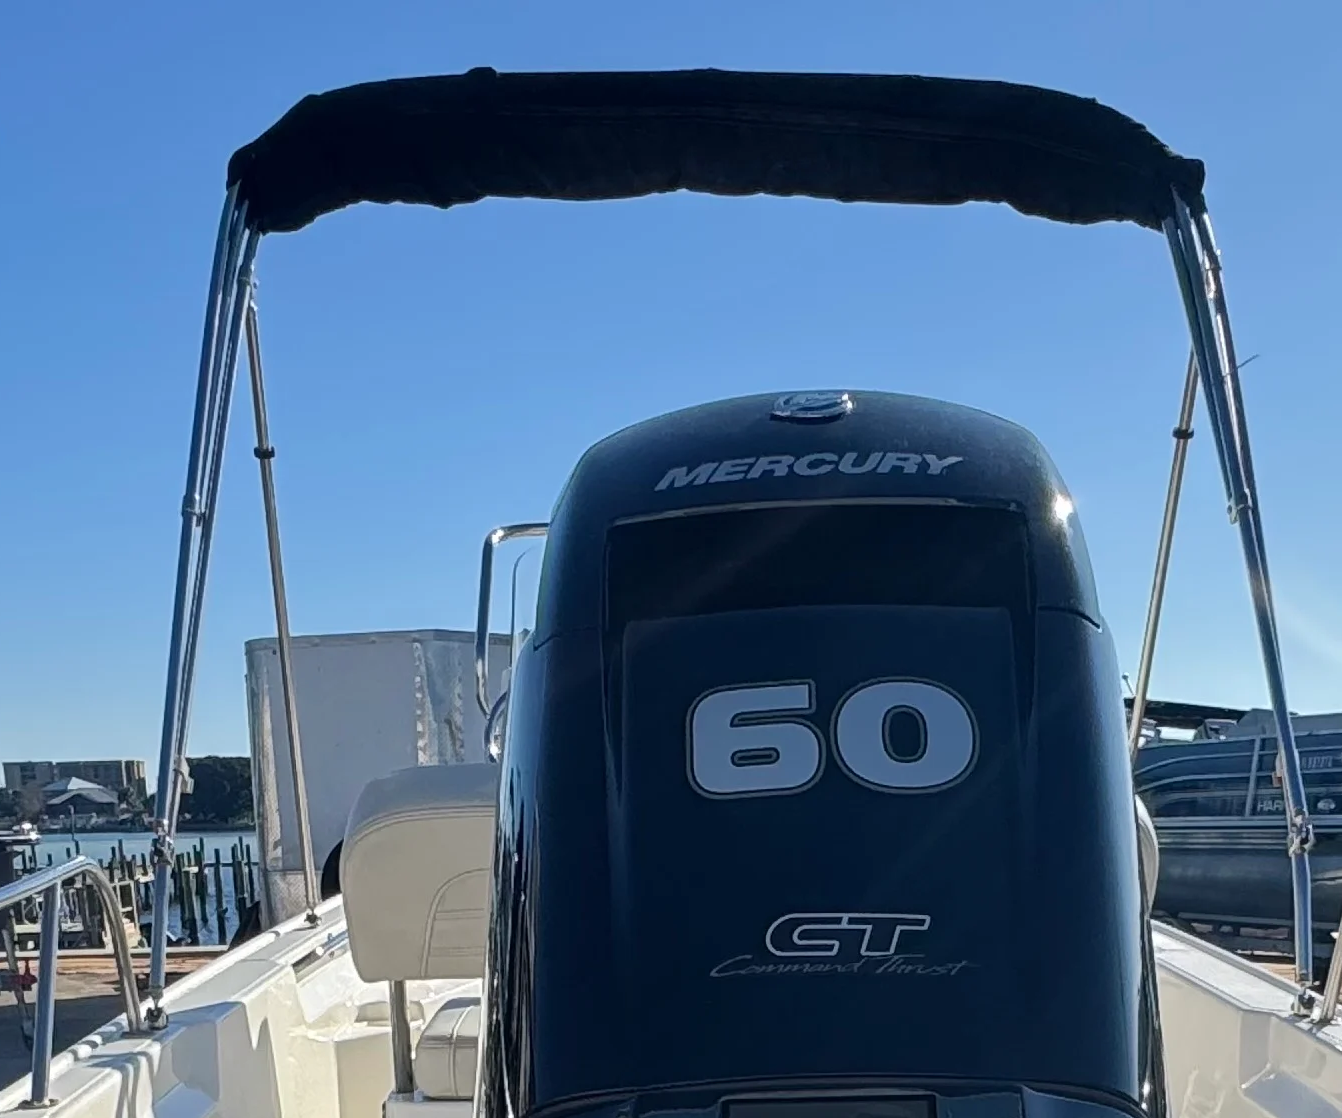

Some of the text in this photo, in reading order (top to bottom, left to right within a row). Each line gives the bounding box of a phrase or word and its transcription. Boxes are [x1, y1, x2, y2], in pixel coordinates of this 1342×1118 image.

[654, 452, 963, 491] MERCURY
[685, 675, 980, 800] 60
[710, 953, 981, 978] Command Thrust
